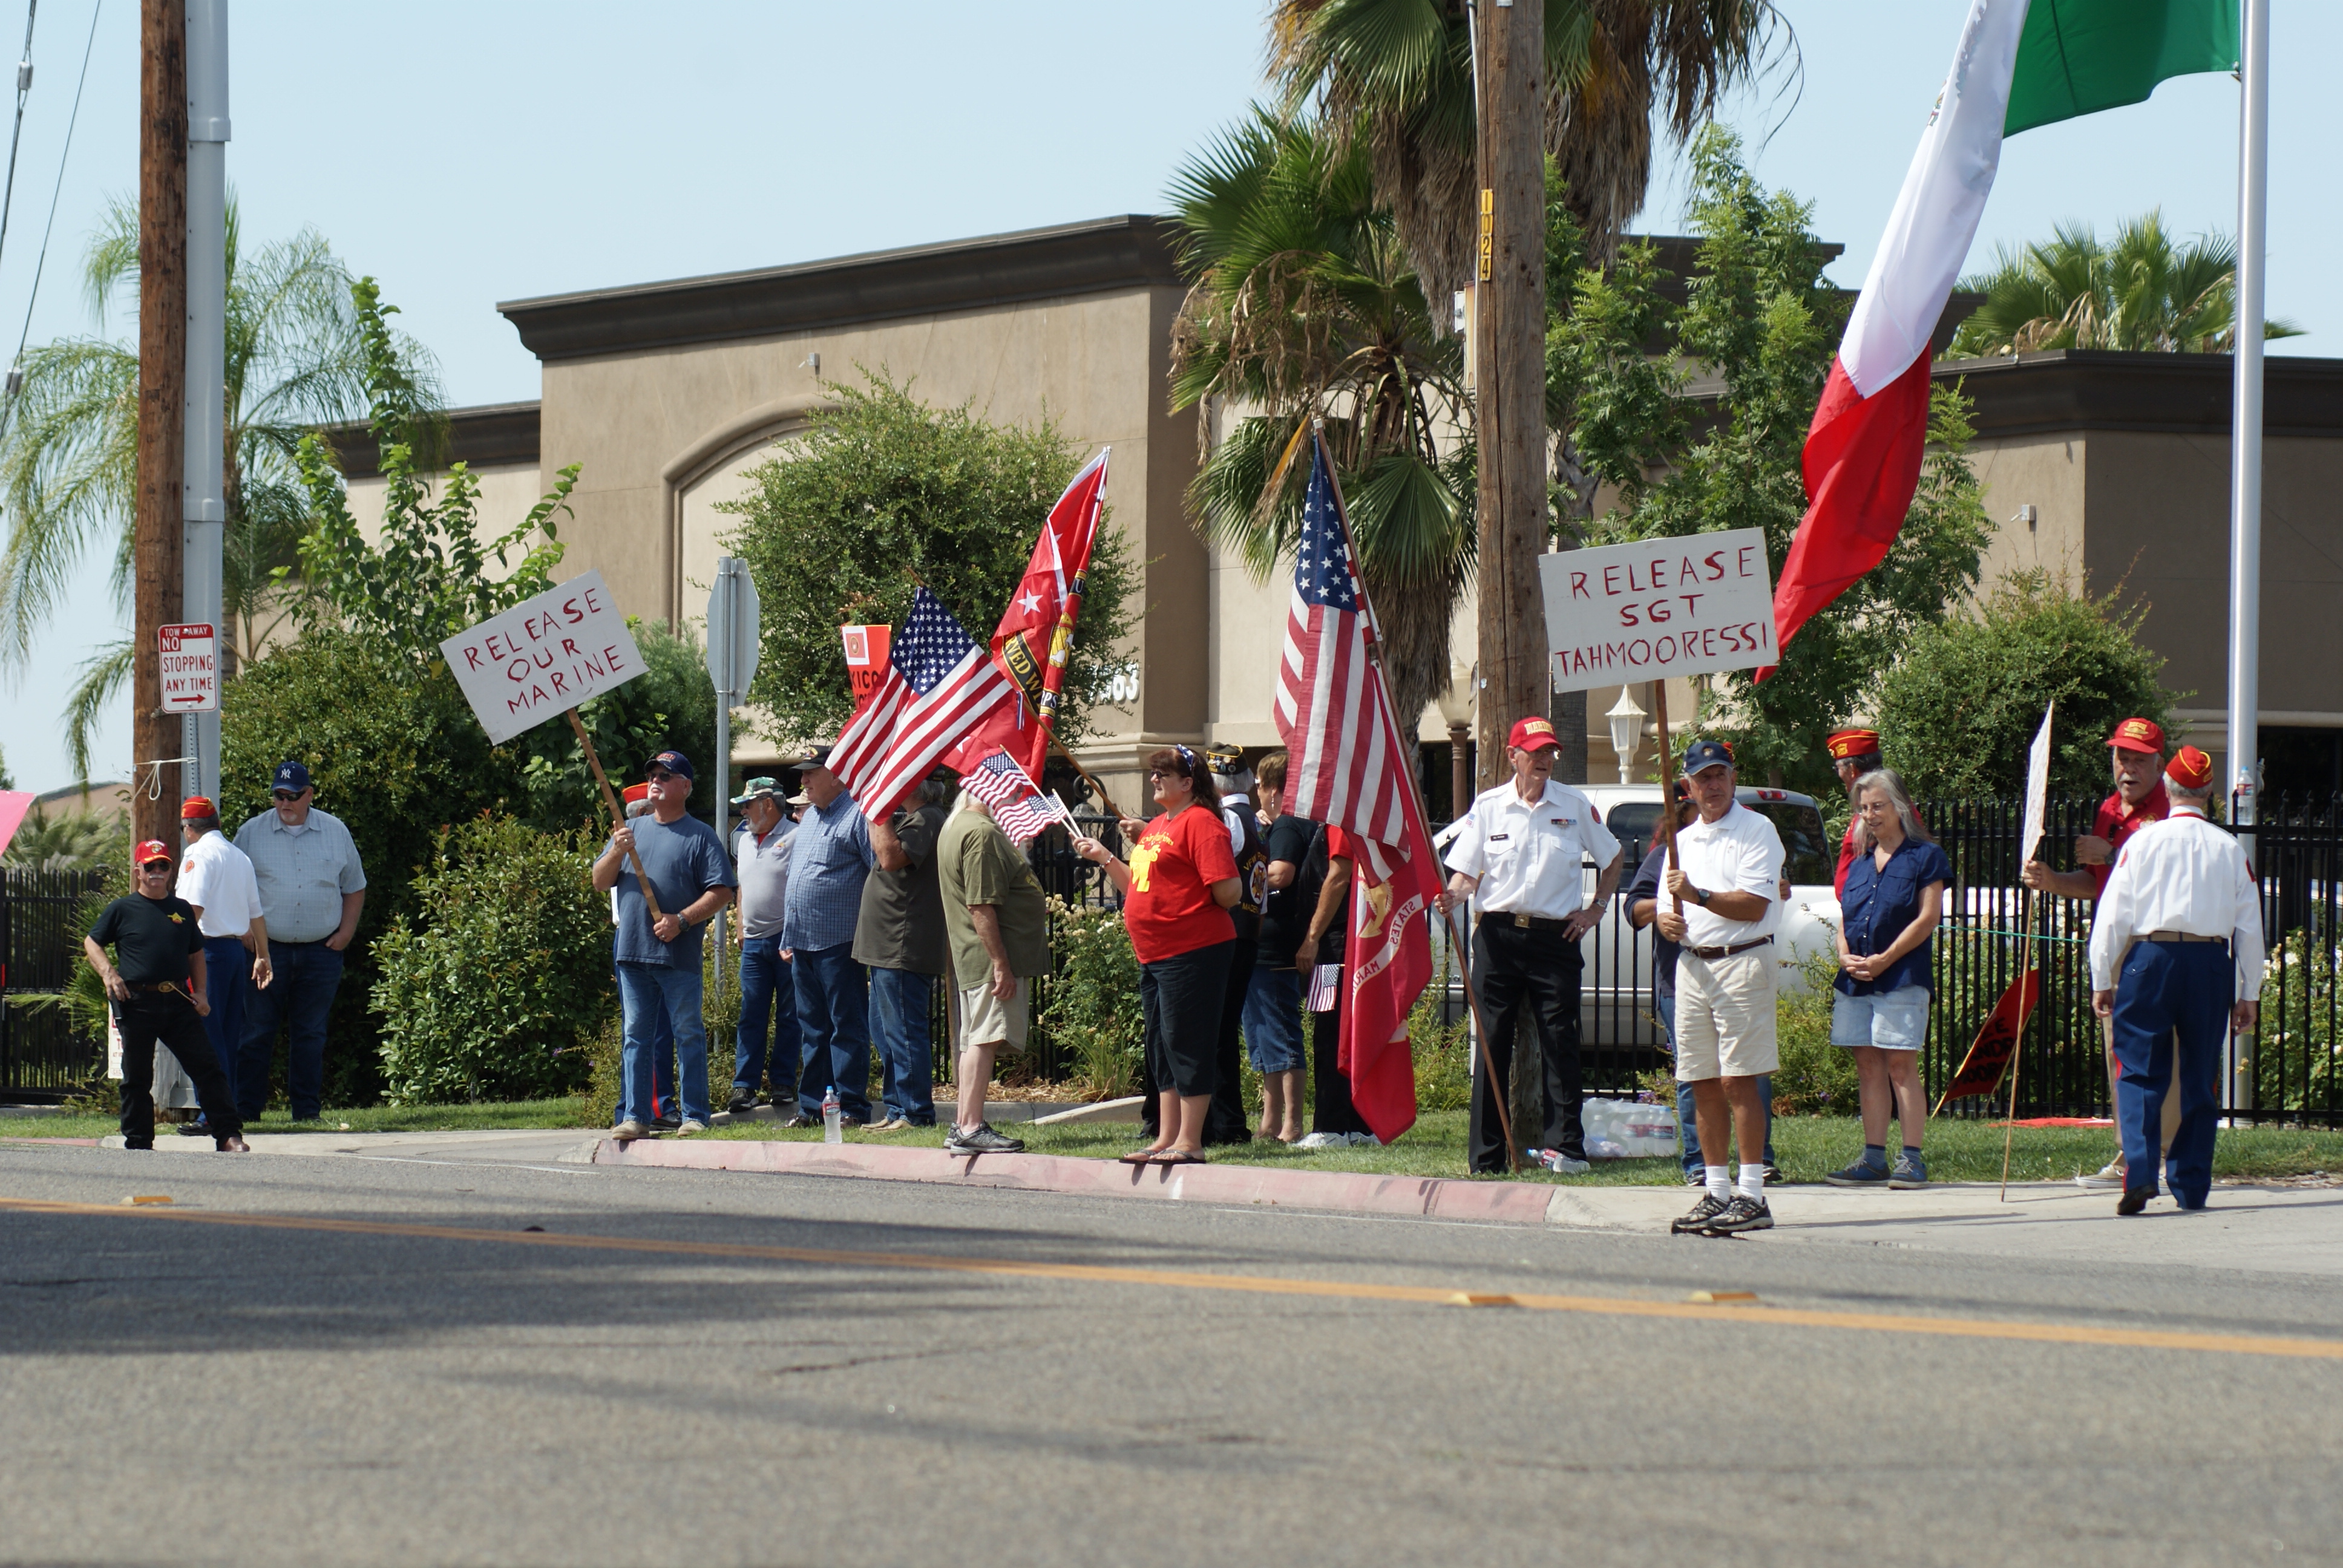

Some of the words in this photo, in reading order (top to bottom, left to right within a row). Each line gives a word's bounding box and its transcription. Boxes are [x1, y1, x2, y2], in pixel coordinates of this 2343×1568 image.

[1482, 192, 1491, 278] 1024
[1570, 546, 1755, 599] RELEASE
[1620, 593, 1705, 627] SGT
[162, 637, 180, 651] NO
[165, 628, 180, 637] TOW
[463, 588, 601, 672] RELEASE
[163, 655, 213, 673] STOPPING
[506, 645, 625, 715] MARINE
[507, 638, 582, 683] OUR
[165, 678, 185, 692] ANY
[190, 677, 213, 691] TIME
